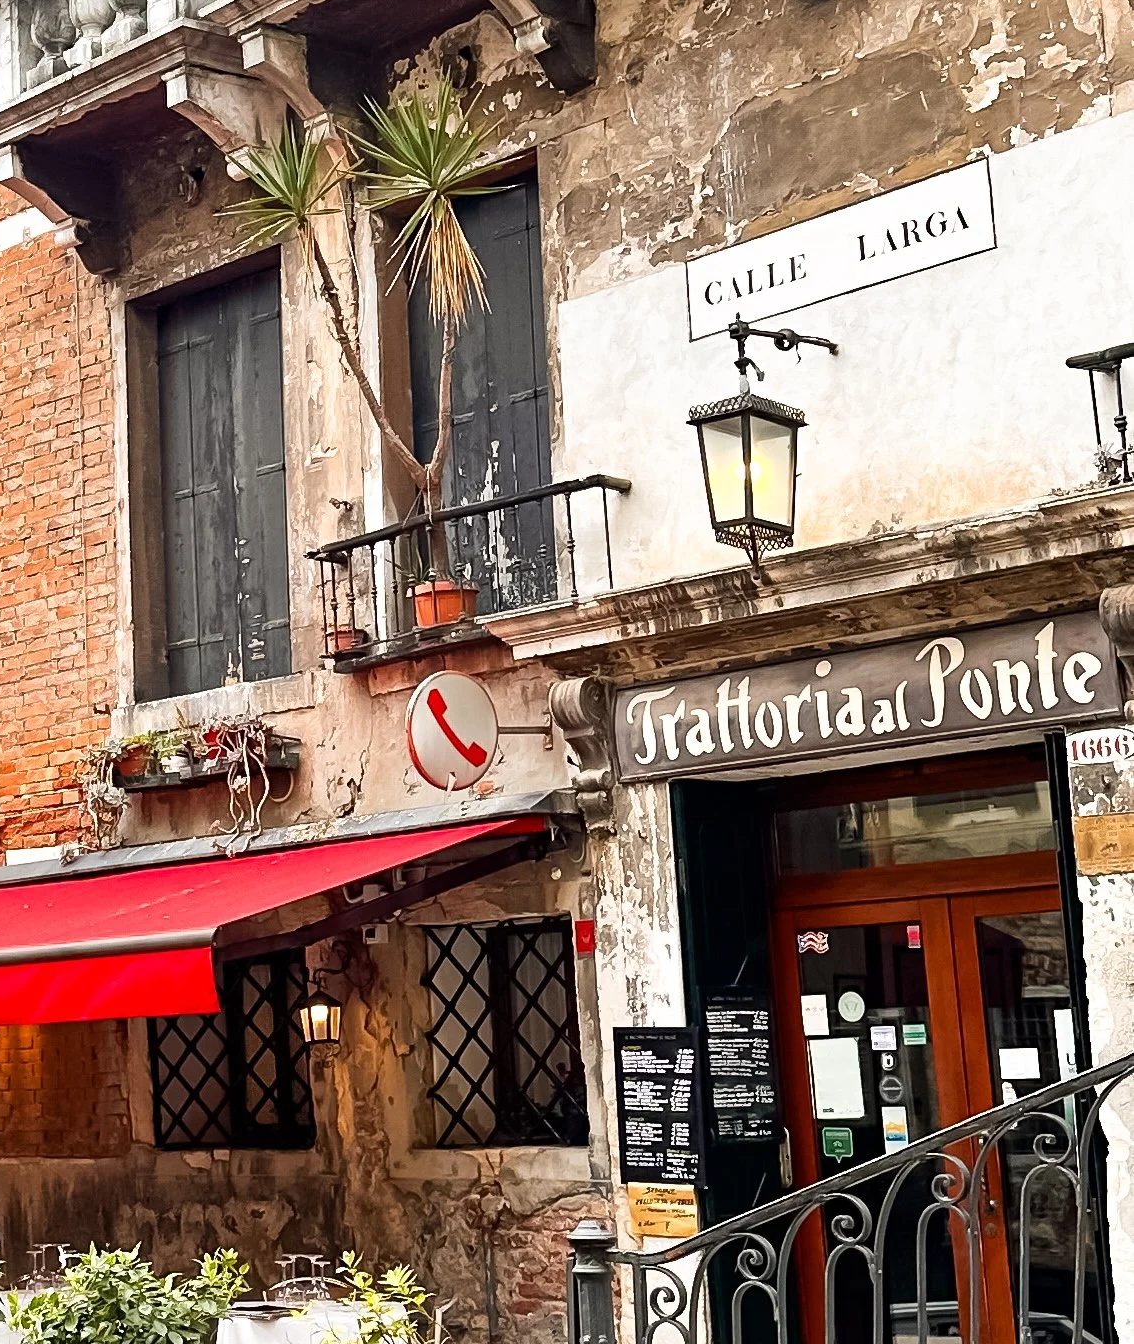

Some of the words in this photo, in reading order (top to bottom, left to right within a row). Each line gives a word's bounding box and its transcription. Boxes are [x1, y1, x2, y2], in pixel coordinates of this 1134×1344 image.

[704, 253, 807, 306] CALLE
[857, 206, 969, 261] LARGA
[626, 660, 866, 765] Trattoria
[870, 680, 911, 735] al
[915, 621, 1102, 728] Ponte
